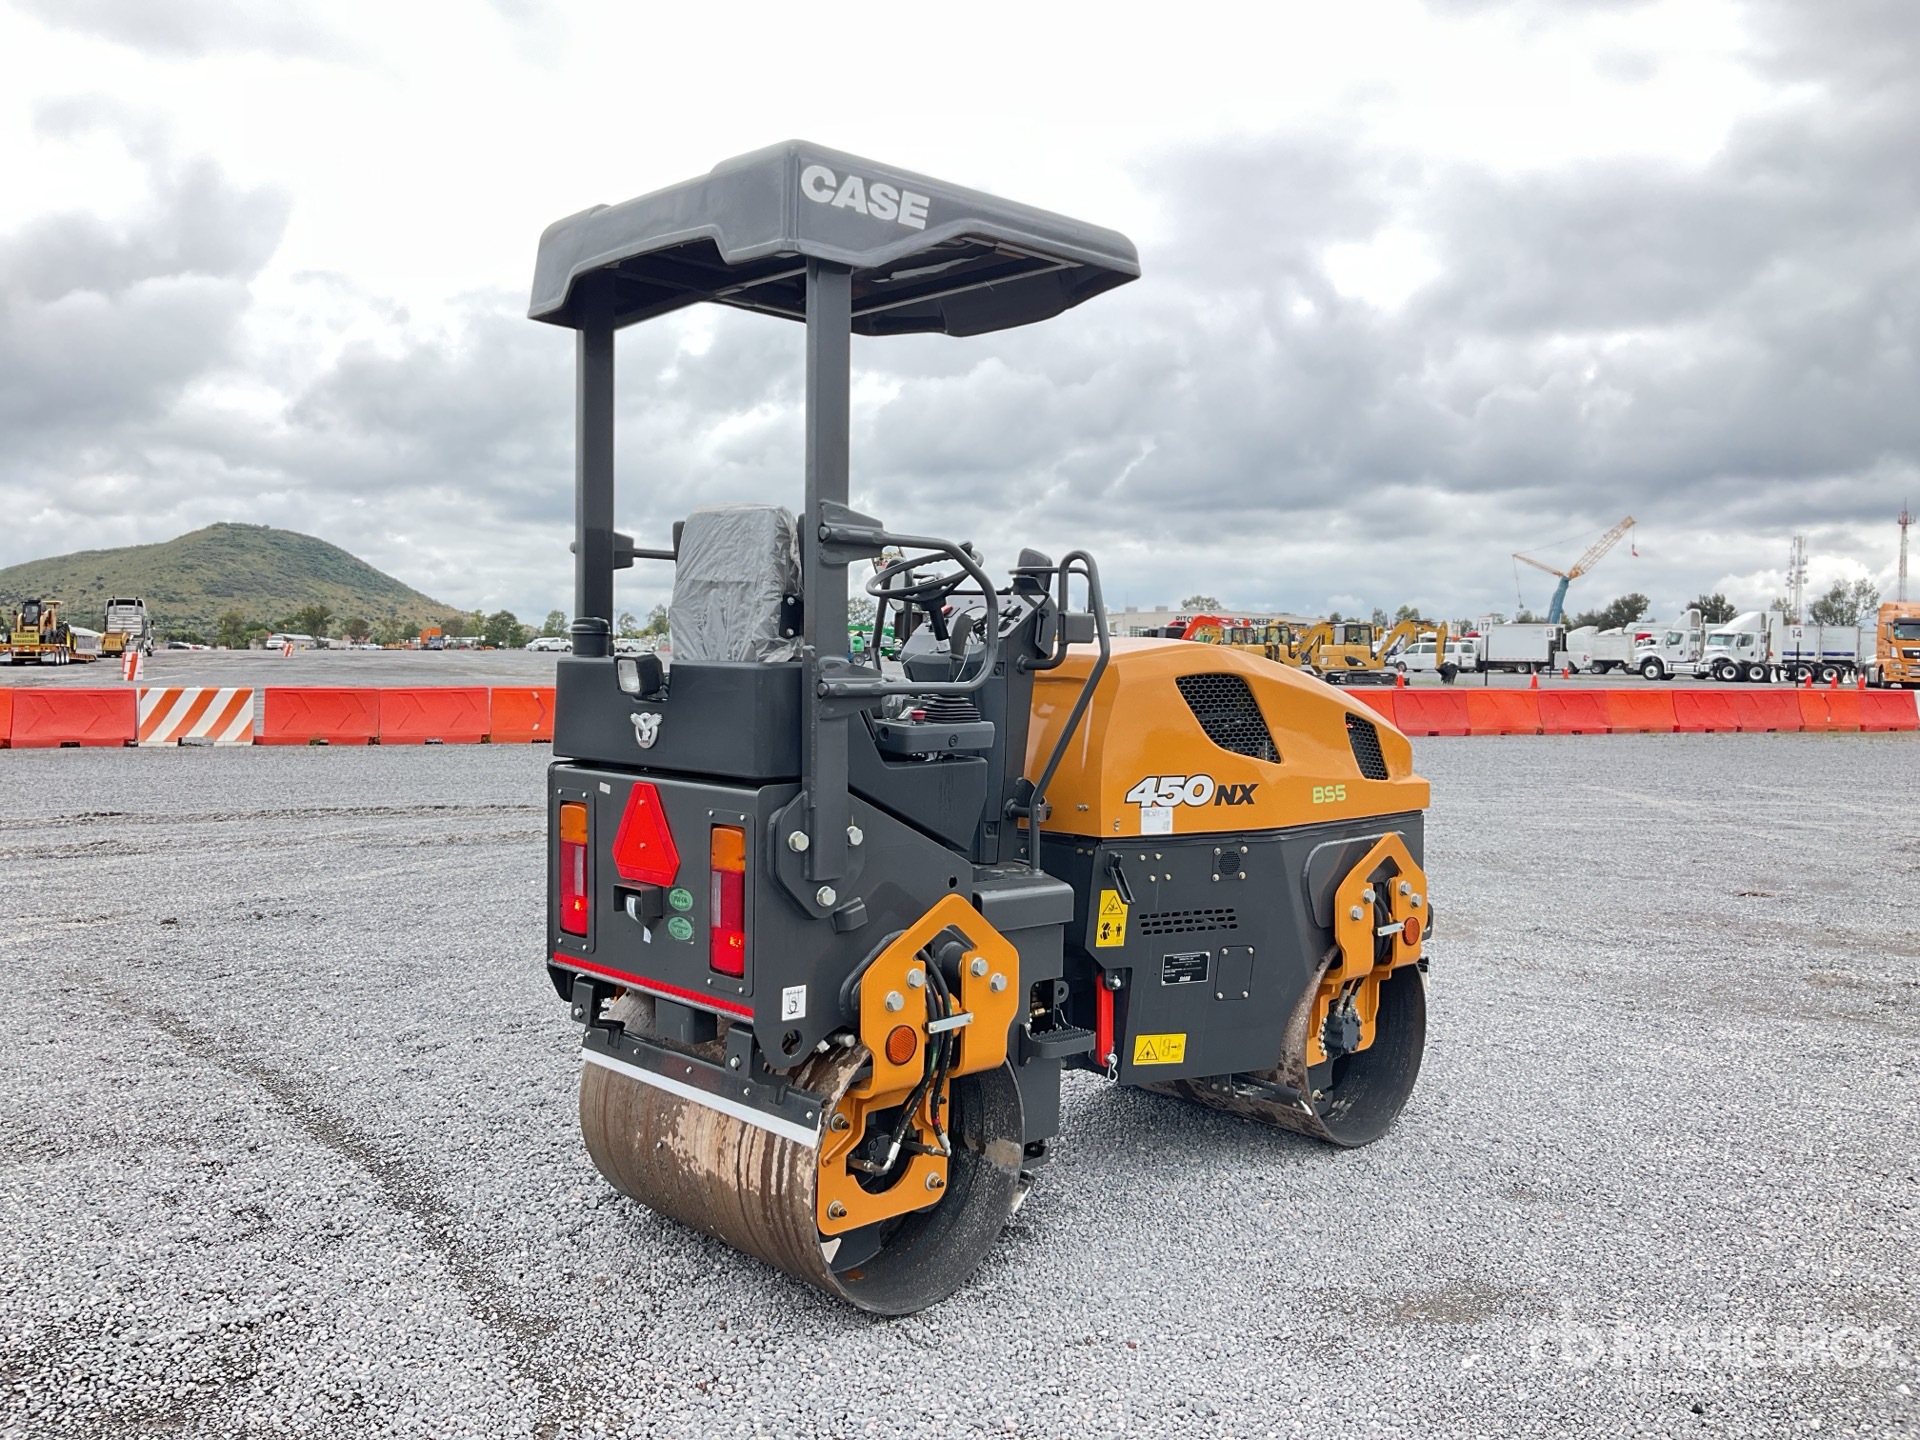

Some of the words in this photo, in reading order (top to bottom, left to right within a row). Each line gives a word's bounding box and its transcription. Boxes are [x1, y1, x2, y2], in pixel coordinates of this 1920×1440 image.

[801, 165, 930, 230] CASE
[1480, 622, 1491, 632] 17
[1546, 630, 1554, 638] 13
[1791, 629, 1803, 639] 14
[1124, 773, 1215, 808] 450
[1214, 783, 1260, 806] NX
[1312, 784, 1347, 804] BS5
